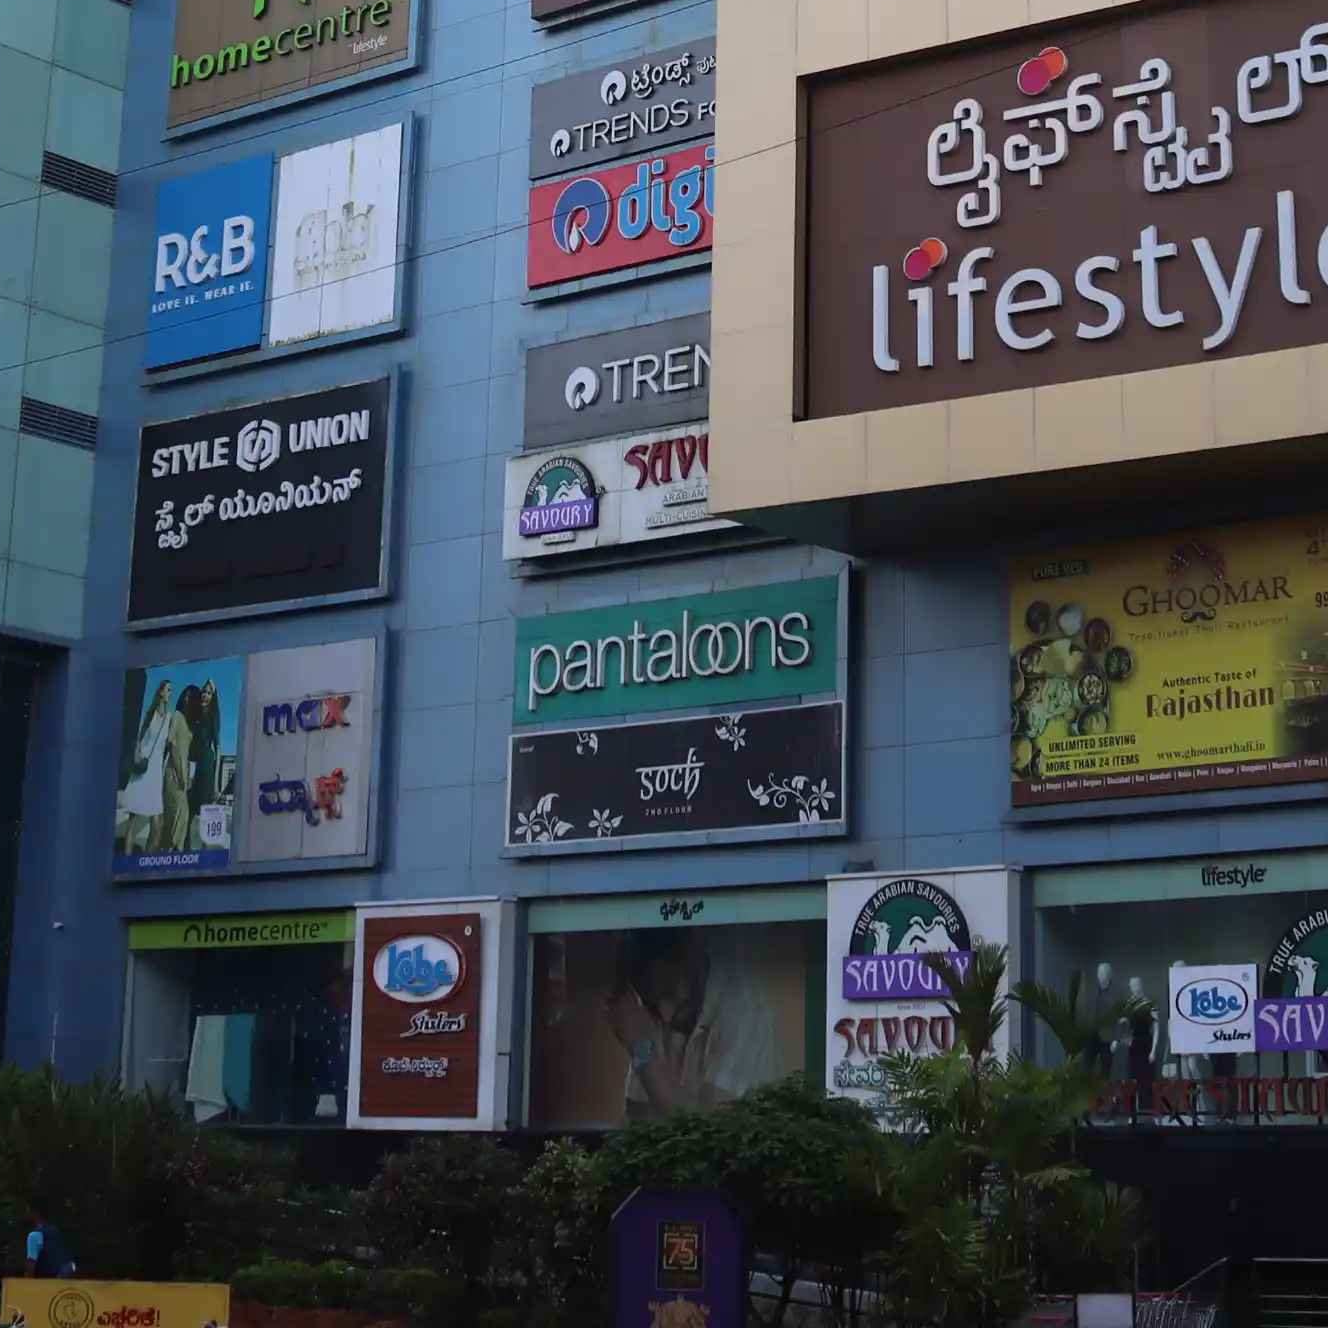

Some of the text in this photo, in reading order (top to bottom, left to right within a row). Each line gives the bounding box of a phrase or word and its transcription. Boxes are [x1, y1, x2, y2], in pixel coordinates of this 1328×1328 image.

[573, 99, 690, 151] TRENDS
[154, 215, 256, 294] R&B
[152, 298, 180, 313] LOVE
[205, 286, 234, 301] WEAR
[152, 410, 370, 478] STYLE UNION
[521, 504, 592, 531] SAVOURY
[1122, 576, 1294, 617] GHOOMAR
[528, 609, 811, 712] pantaloons
[1162, 669, 1257, 688] Authentic Taste of
[263, 695, 352, 737] max
[1146, 685, 1275, 720] Rajasthan
[1048, 734, 1137, 753] UNLIMITED SERVING
[1046, 760, 1070, 773] MORE
[1074, 758, 1096, 770] THAN
[1112, 754, 1140, 766] ITEMS
[665, 804, 693, 815] FLOOR
[139, 853, 200, 866] GROUND FLOOR
[1201, 864, 1266, 888] lifestyle
[855, 882, 960, 937] TRUE ARABIAN SAVOURIES
[205, 920, 321, 944] homecentre
[1271, 937, 1296, 975] TRUE
[845, 957, 970, 993] SAVOUY
[1189, 987, 1243, 1019] Kobe
